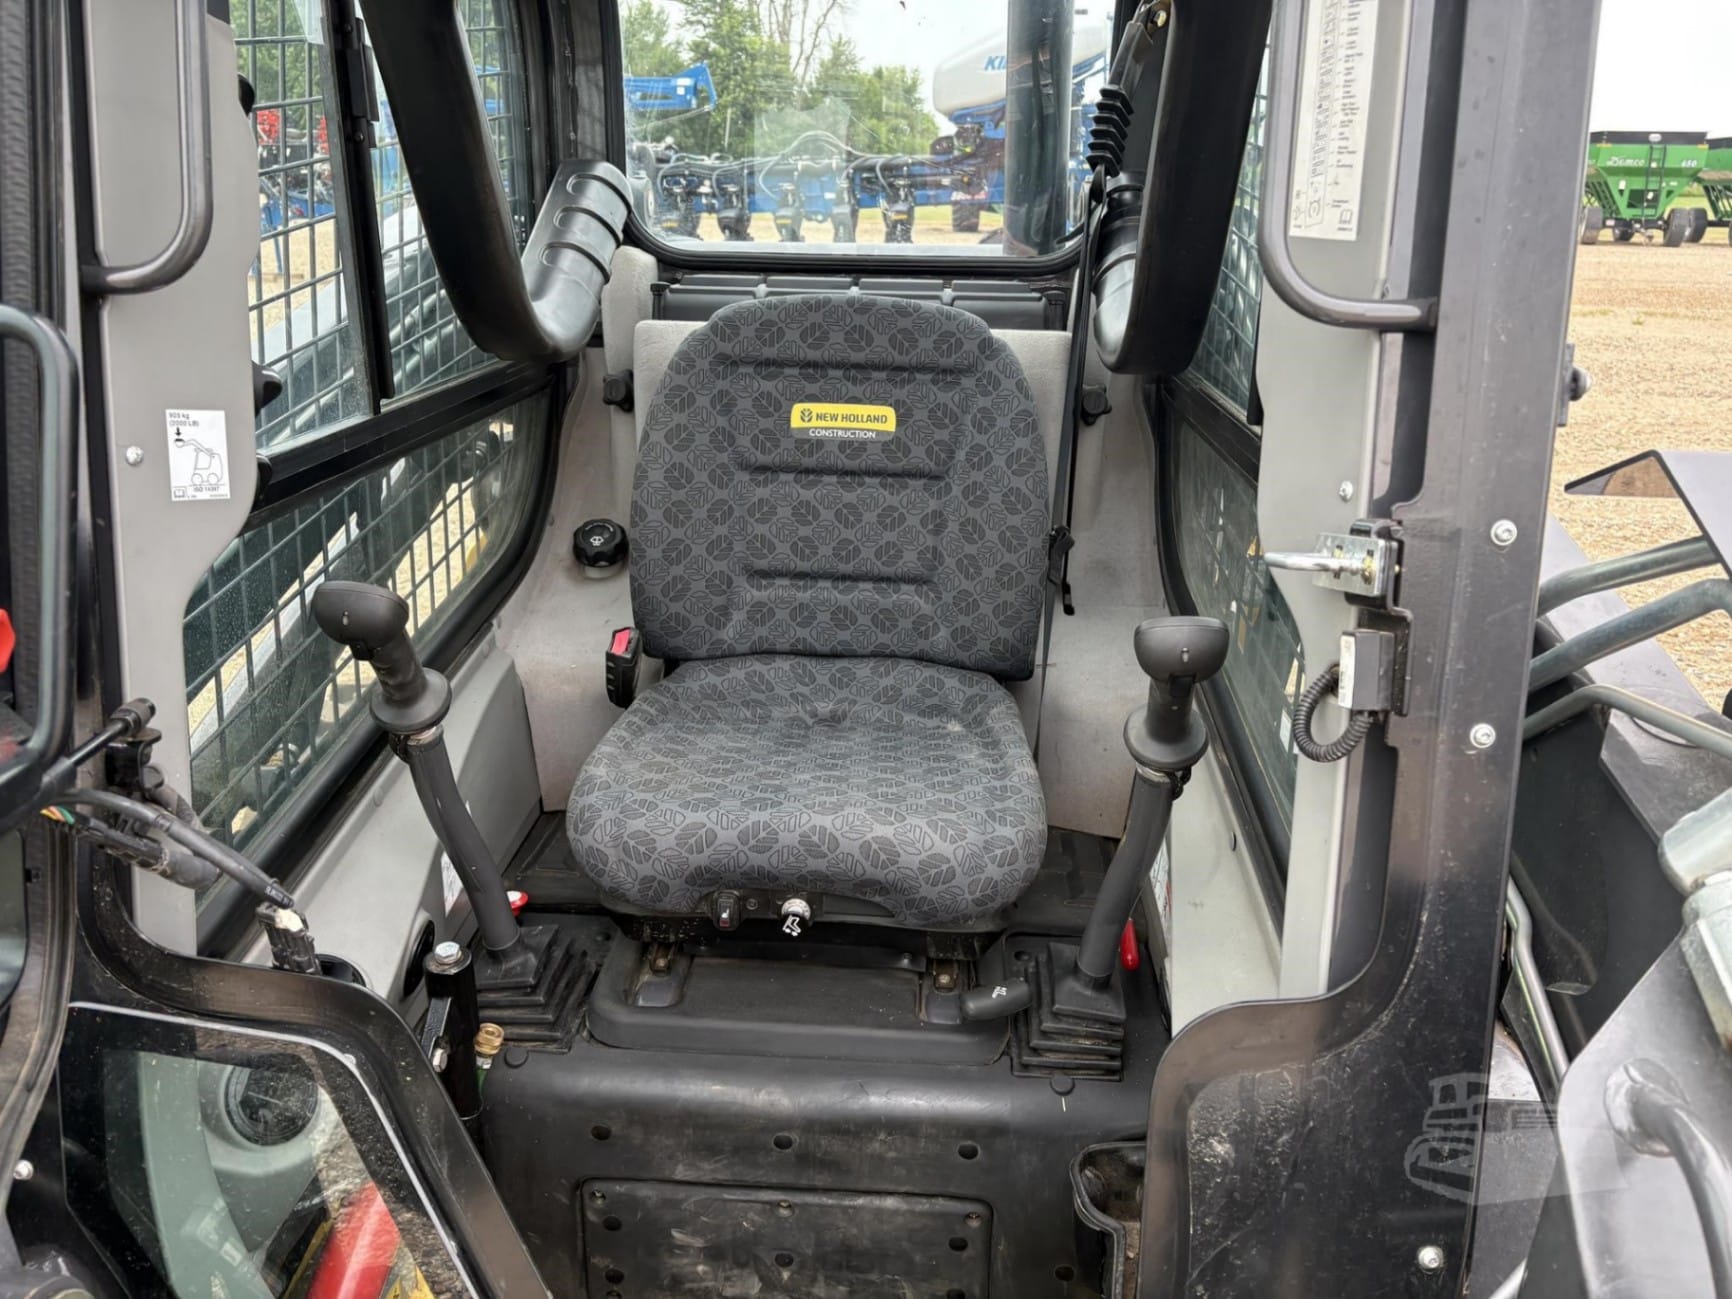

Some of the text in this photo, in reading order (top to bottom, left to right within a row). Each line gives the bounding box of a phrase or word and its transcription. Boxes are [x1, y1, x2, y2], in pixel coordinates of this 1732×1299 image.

[816, 412, 888, 424] NEW HOLLAND
[809, 428, 876, 438] CONSTRUCTION
